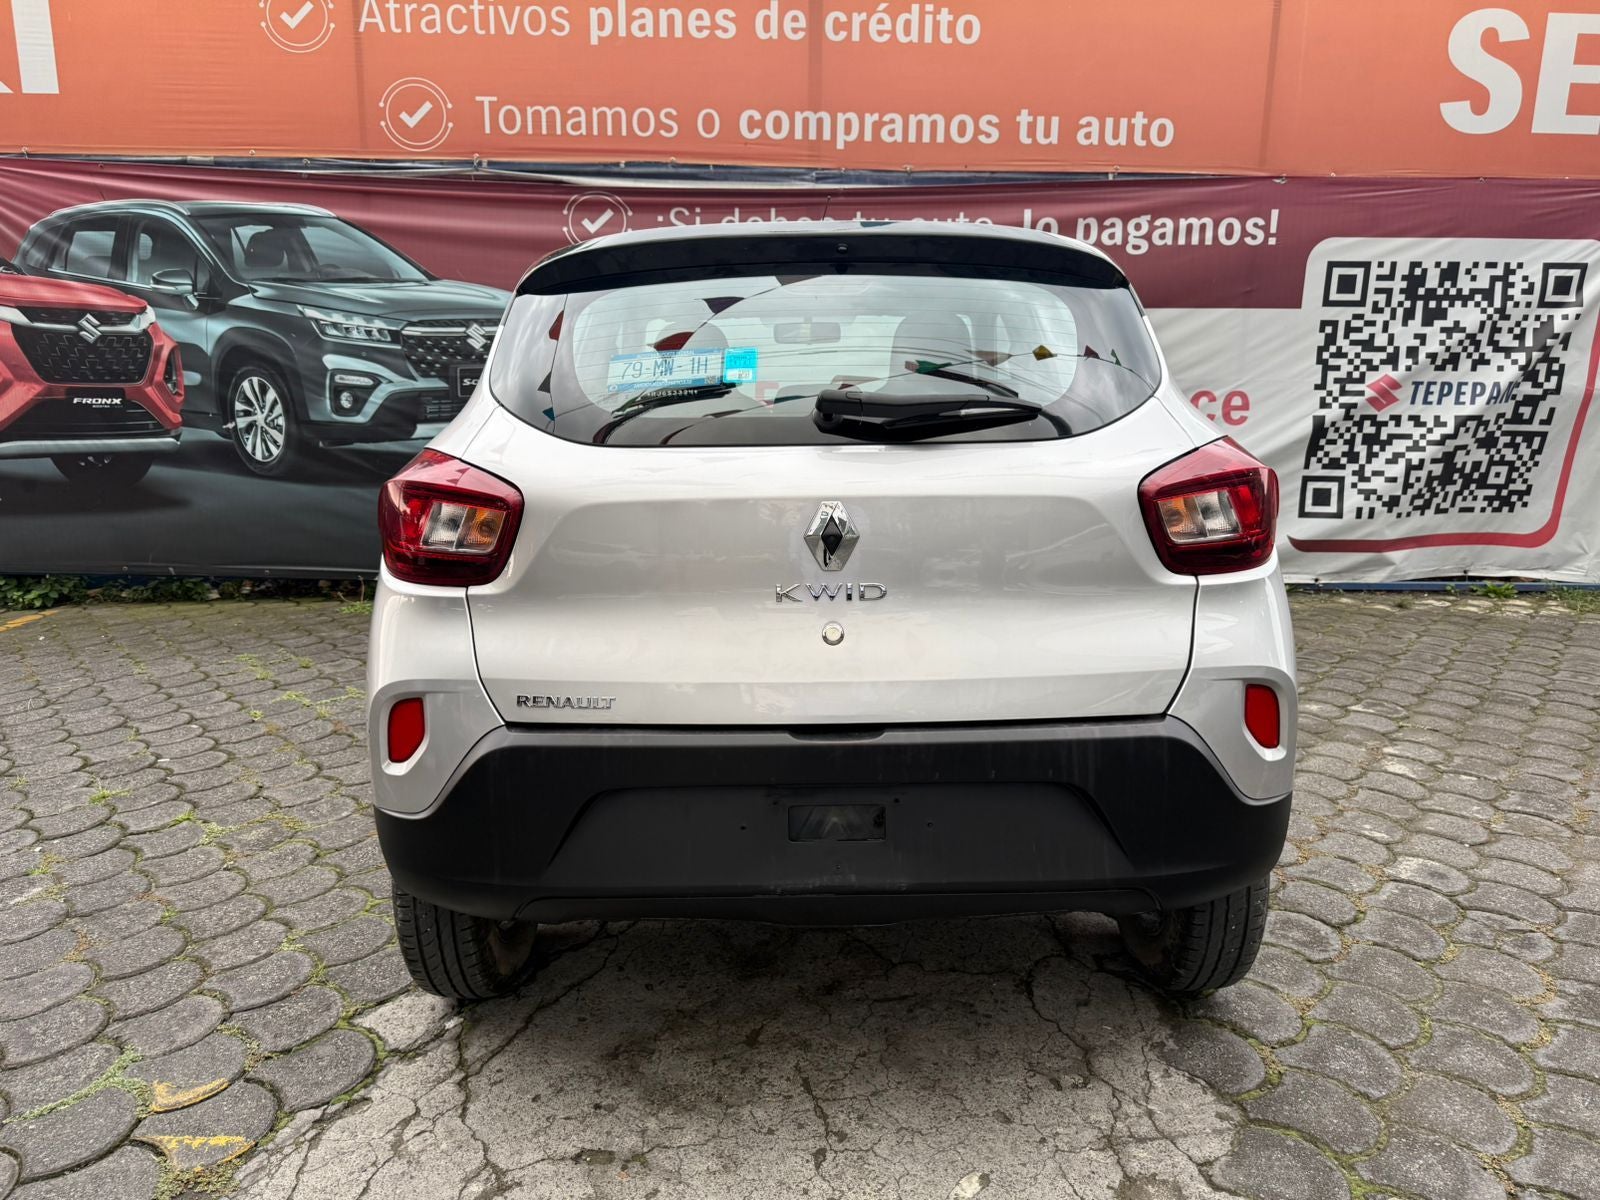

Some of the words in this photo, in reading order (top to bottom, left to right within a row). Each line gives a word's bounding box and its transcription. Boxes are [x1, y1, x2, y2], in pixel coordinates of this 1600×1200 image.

[358, 0, 571, 37] Atractivos
[589, 0, 737, 46] planes
[754, 0, 807, 41] de
[824, 3, 981, 45] crédito
[475, 96, 679, 138] Tomamos
[696, 108, 721, 139] o
[738, 108, 1000, 150] compramos
[1016, 108, 1060, 145] tu
[1076, 110, 1175, 147] auto
[1075, 208, 1280, 256] pagamos!
[72, 397, 122, 405] FRONX
[1409, 380, 1517, 406] TEPEPAN
[775, 582, 888, 603] KWID
[516, 694, 617, 710] RENAULT
